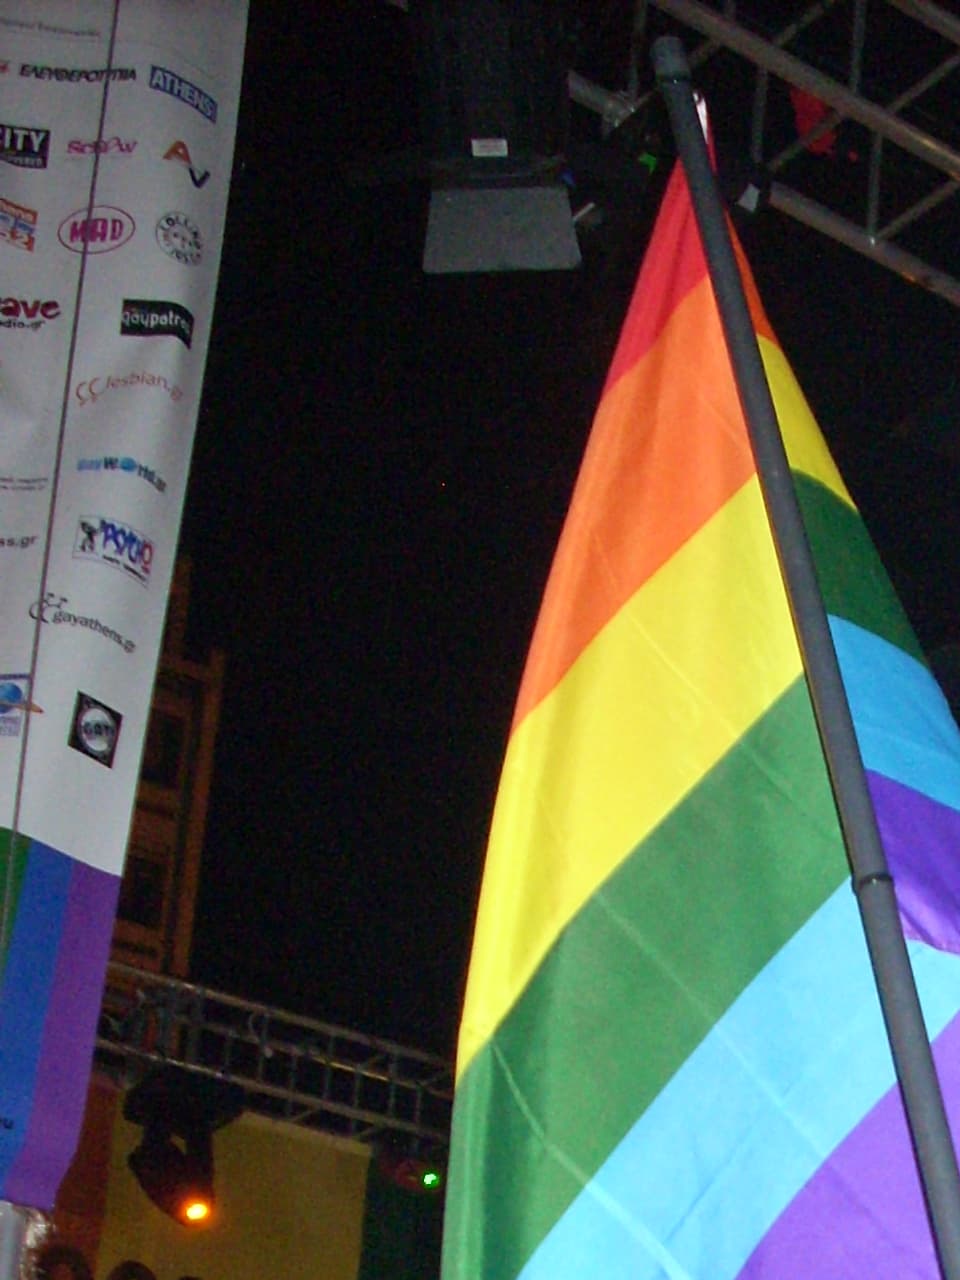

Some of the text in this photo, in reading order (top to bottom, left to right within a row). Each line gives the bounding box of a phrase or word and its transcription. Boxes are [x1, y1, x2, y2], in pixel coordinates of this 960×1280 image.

[0, 126, 47, 153] ITY
[70, 218, 124, 243] MAD
[0, 297, 61, 320] ave
